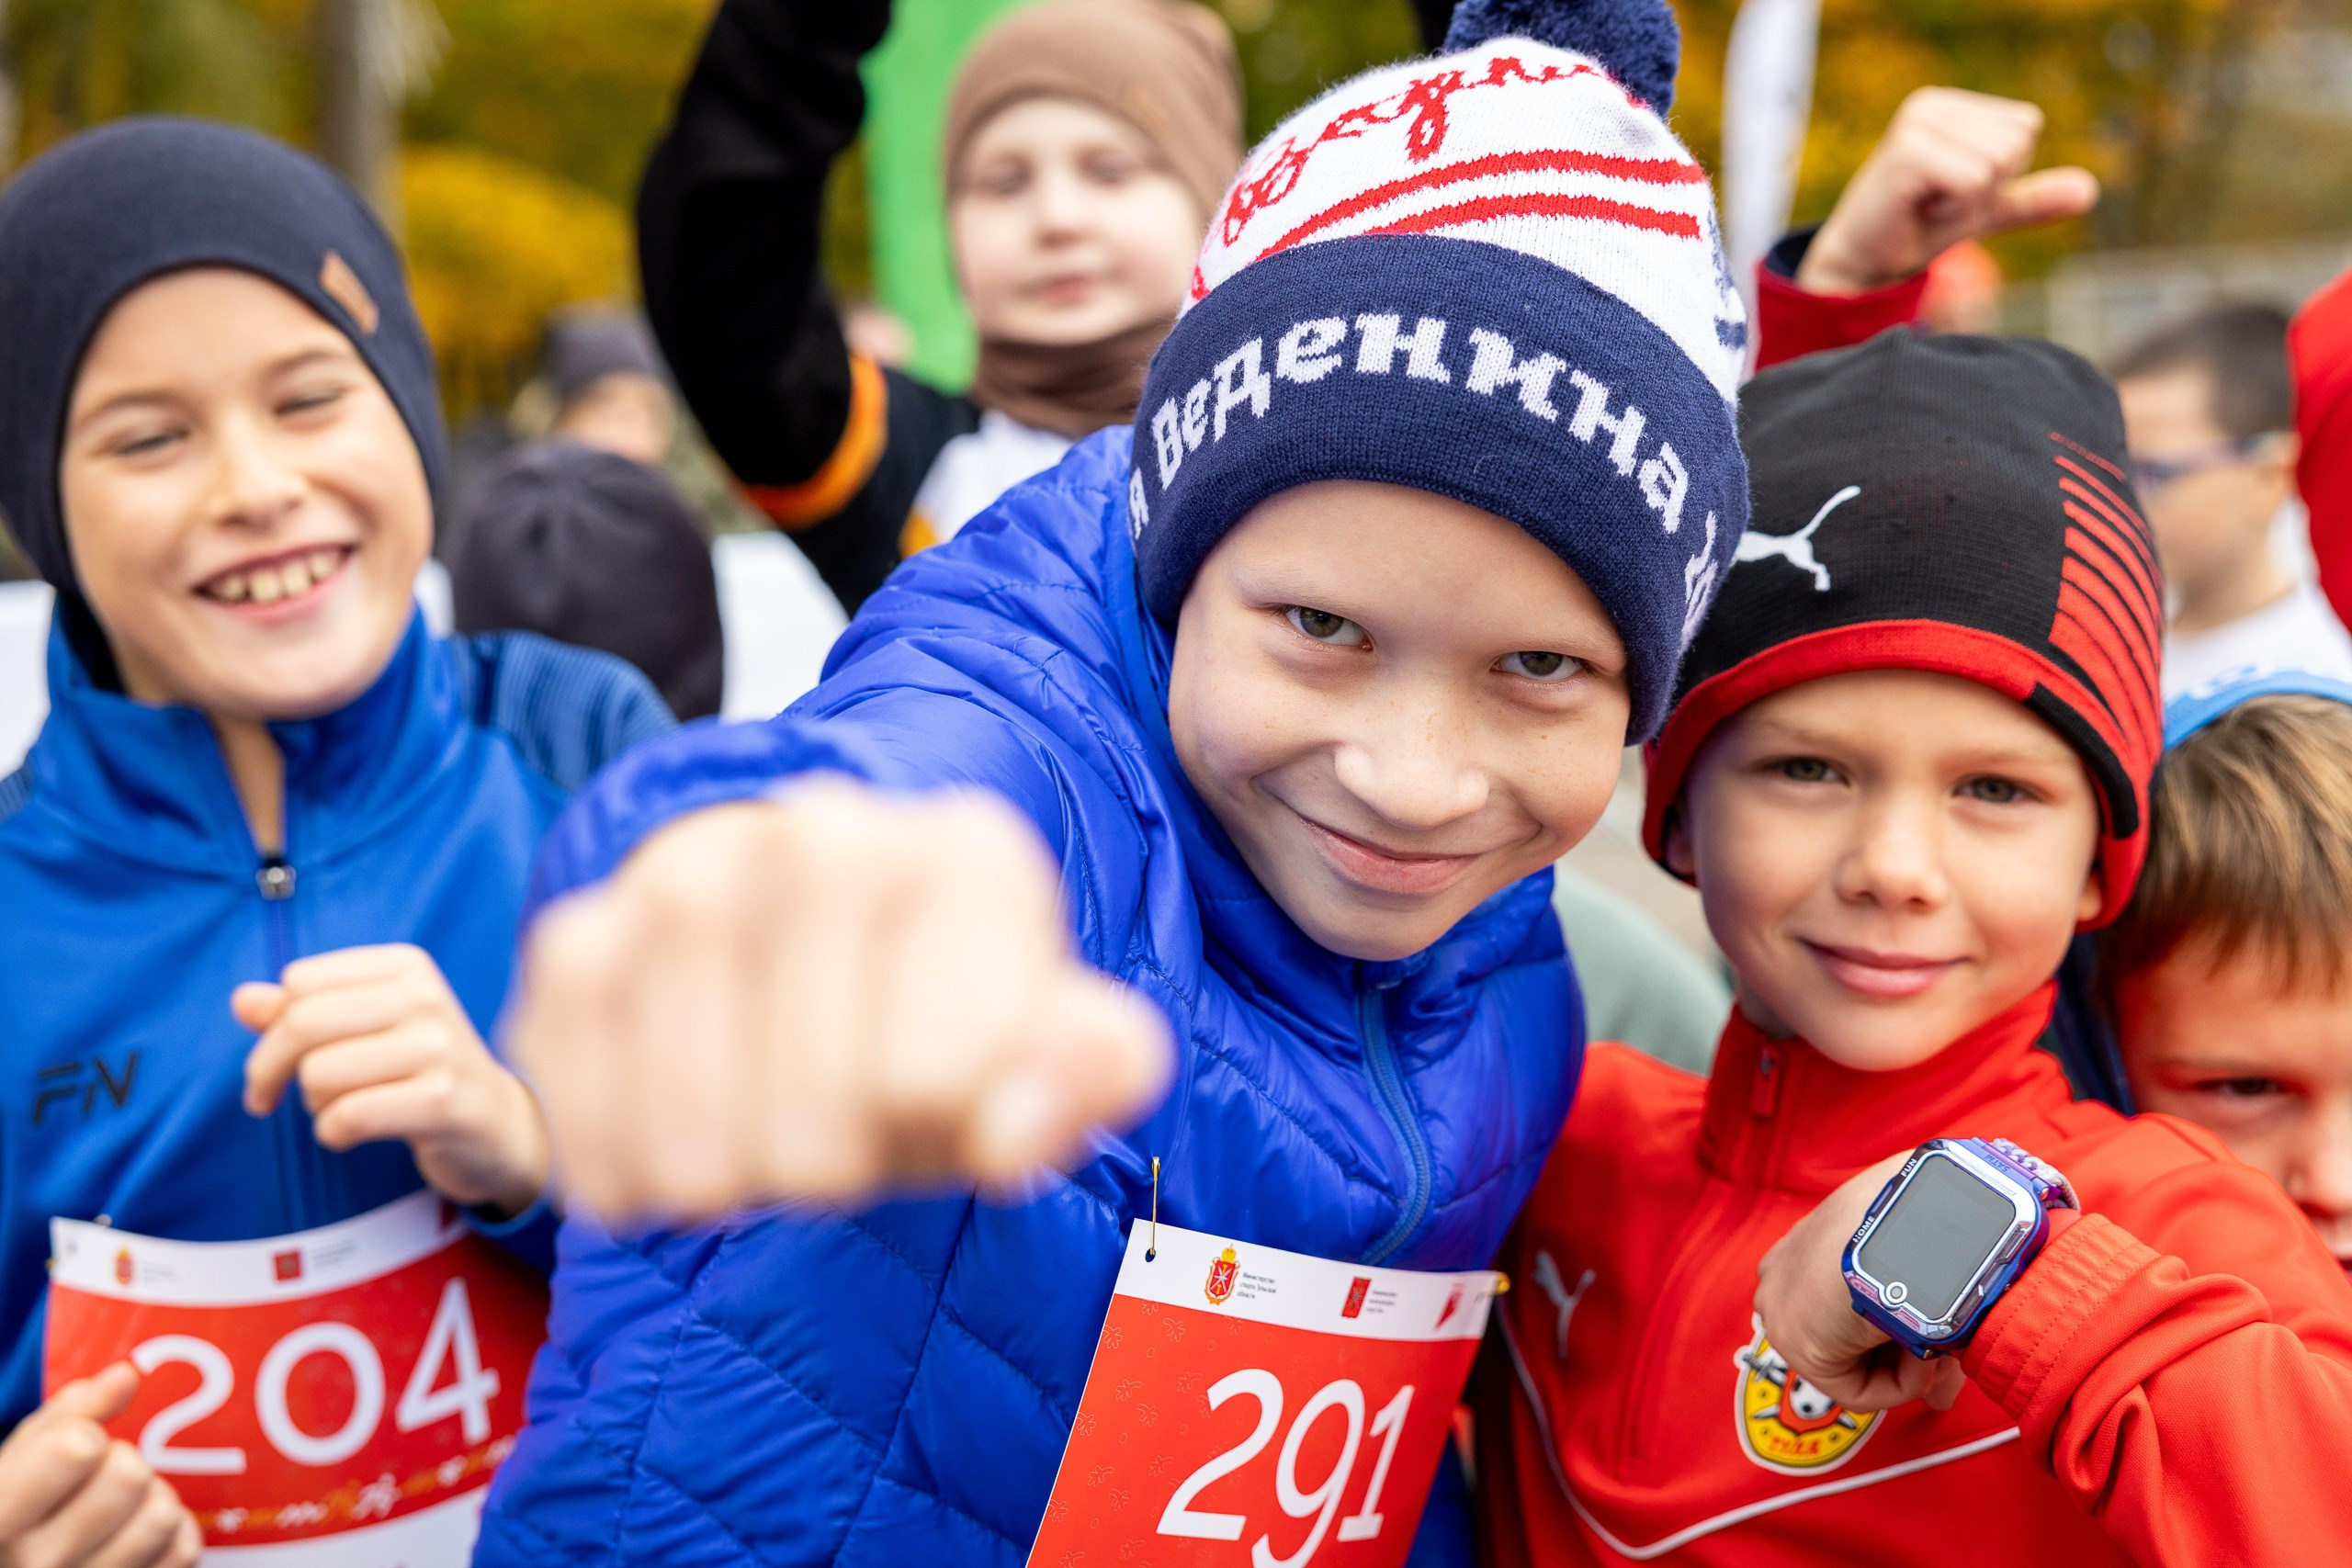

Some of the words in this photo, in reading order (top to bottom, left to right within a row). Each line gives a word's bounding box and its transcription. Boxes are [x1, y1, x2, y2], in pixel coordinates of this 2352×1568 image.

[1153, 312, 1689, 535] Веденина
[1852, 1215, 1875, 1244] HOME
[1900, 1157, 1917, 1178] FUN
[131, 1277, 501, 1474] 204
[1156, 1369, 1414, 1568] 291
